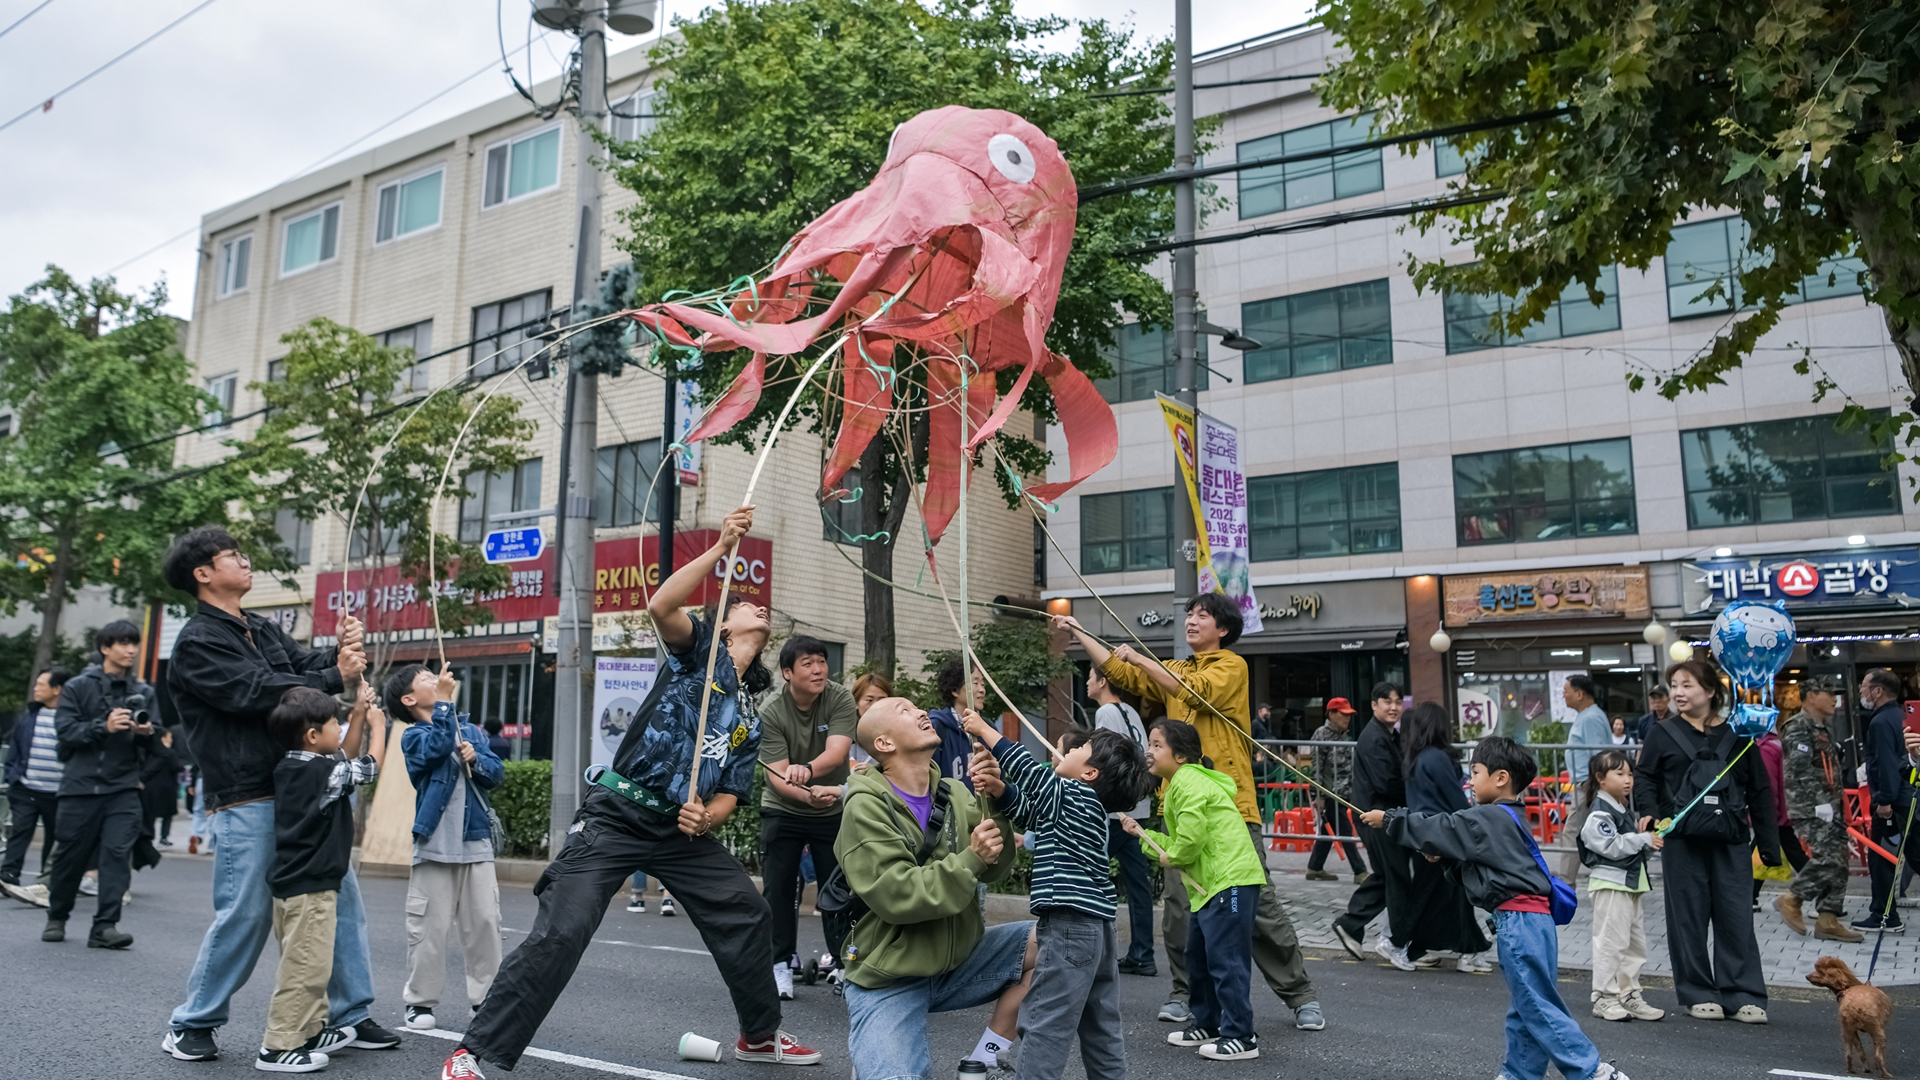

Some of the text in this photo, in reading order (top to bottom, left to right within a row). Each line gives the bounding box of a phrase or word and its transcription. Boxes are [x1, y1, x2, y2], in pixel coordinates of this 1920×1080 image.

[1203, 464, 1243, 492] 동대문
[1208, 534, 1230, 547] 한로
[596, 562, 660, 591] RKING
[715, 555, 765, 584] DOC
[1708, 559, 1891, 600] 대박 소 곱창
[1480, 584, 1536, 611] 흑산도
[598, 662, 656, 672] 동대문페스티벌
[1462, 700, 1493, 730] 회
